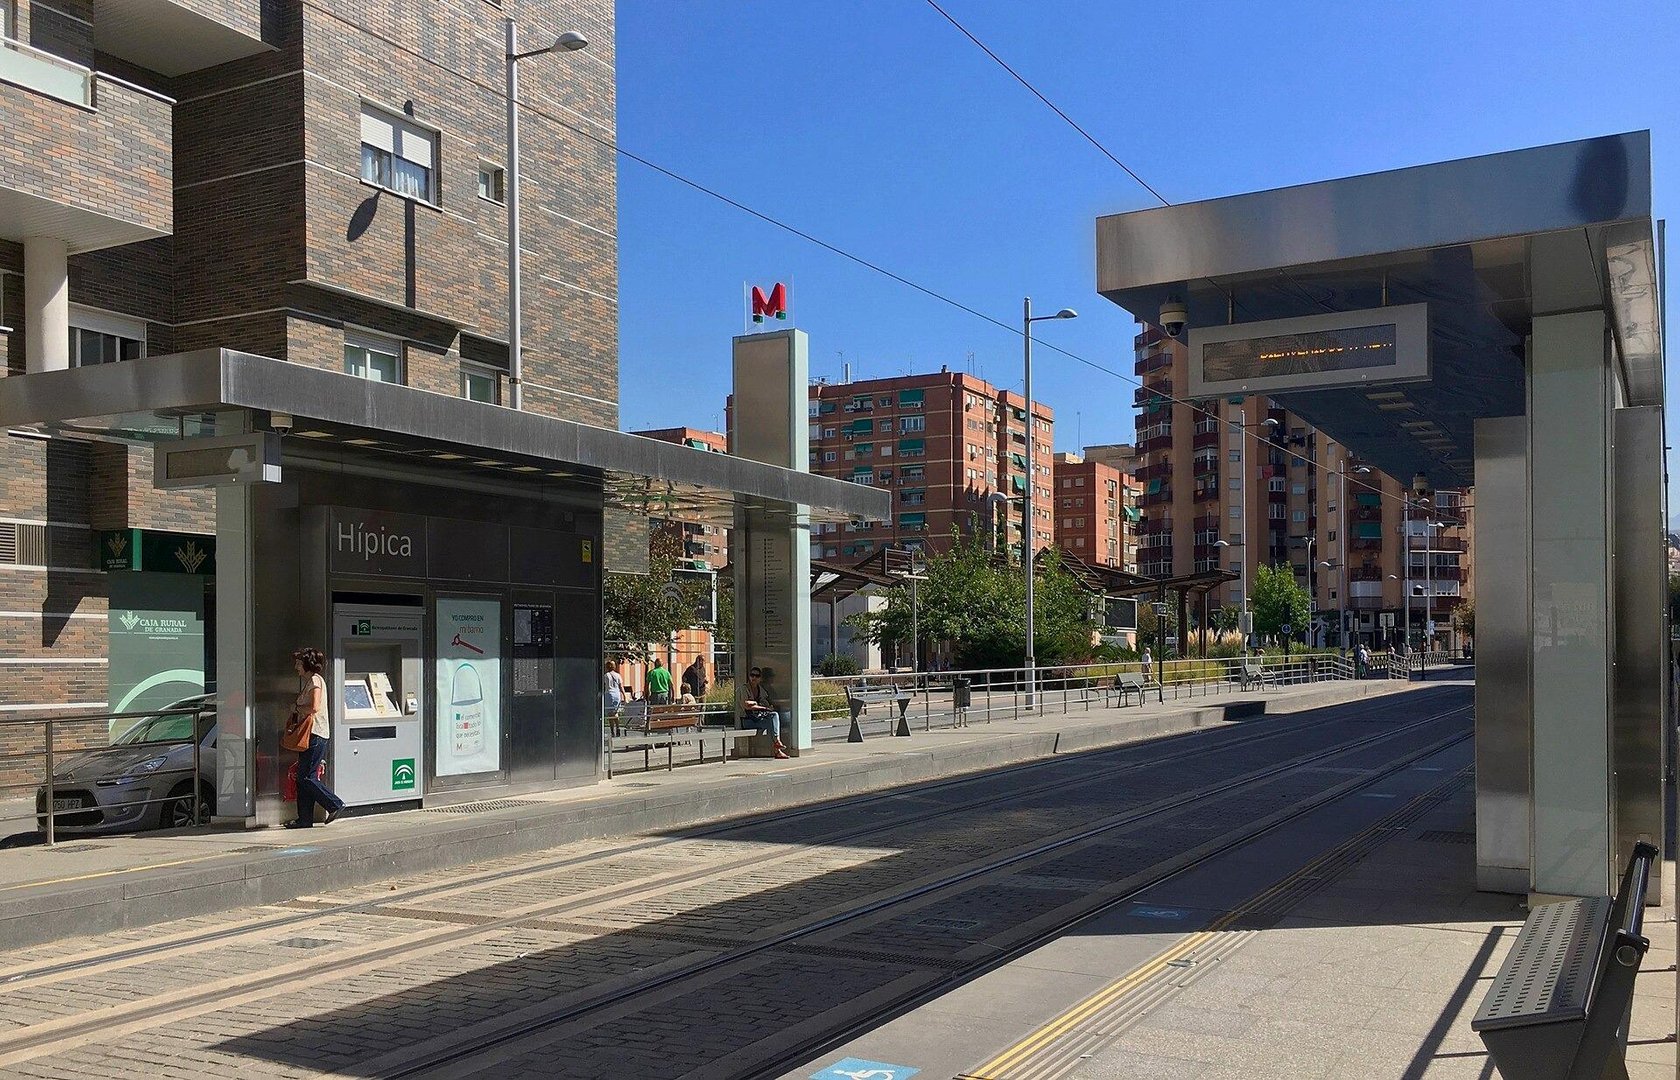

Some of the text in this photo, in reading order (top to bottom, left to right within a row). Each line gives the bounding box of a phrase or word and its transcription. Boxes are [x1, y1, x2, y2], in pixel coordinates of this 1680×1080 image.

[338, 522, 412, 560] Hípica
[139, 619, 187, 628] CAJA RURAL
